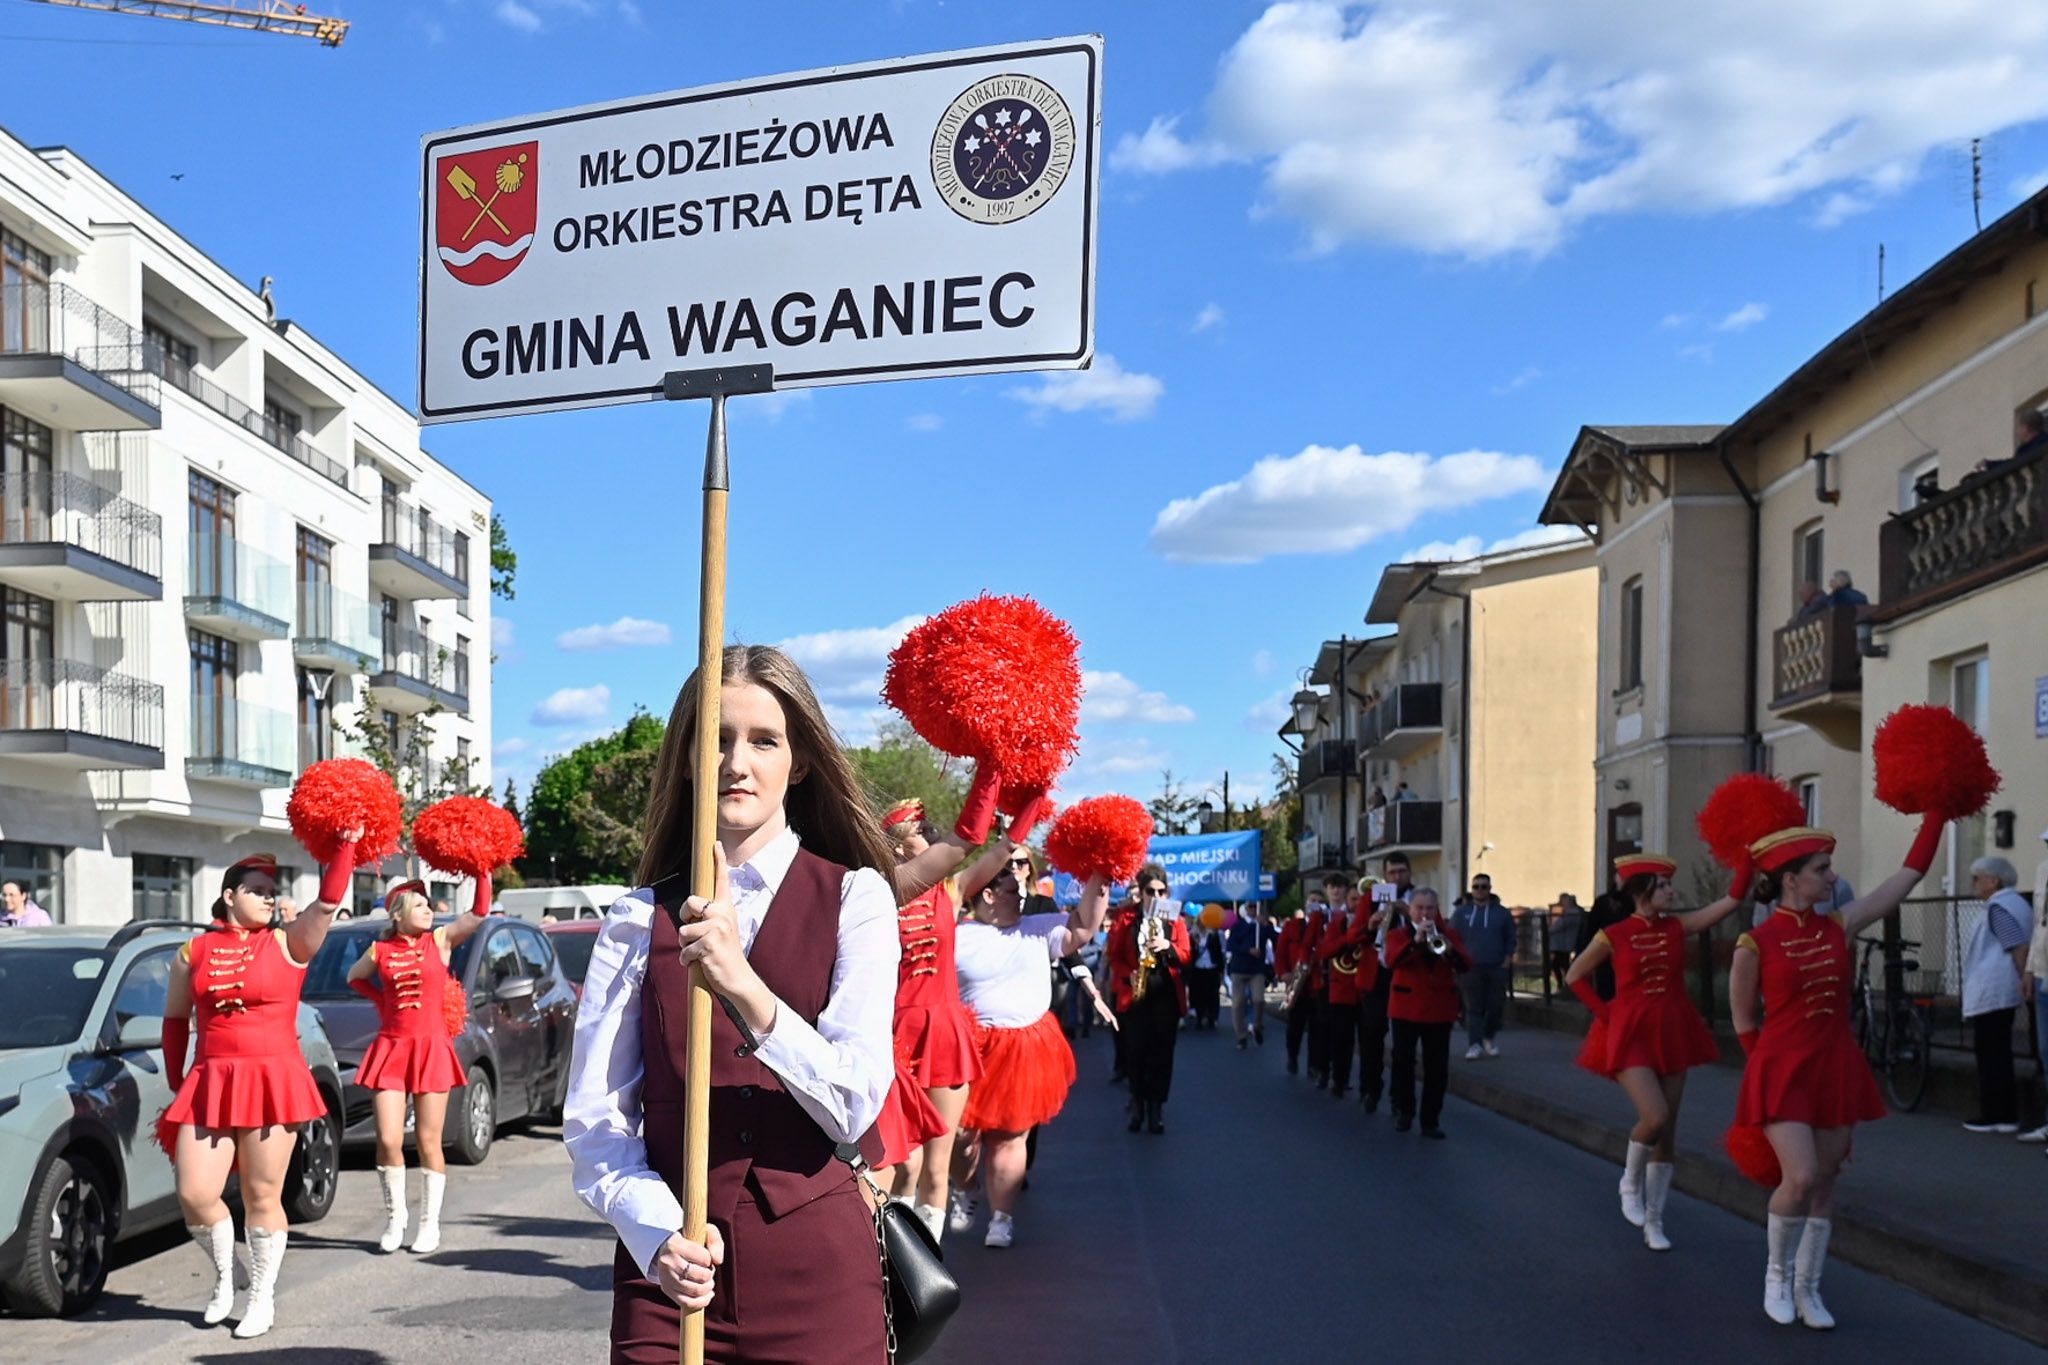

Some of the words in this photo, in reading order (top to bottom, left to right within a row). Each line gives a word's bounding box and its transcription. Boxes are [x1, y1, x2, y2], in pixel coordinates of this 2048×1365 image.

[580, 113, 894, 189] MŁODZIEŻOWA
[966, 80, 1034, 108] ORKIESTRA
[1043, 118, 1070, 191] WAGANIEC
[554, 190, 791, 252] ORKIESTRA
[805, 175, 921, 225] DĘTA
[986, 201, 1015, 217] 1997
[462, 311, 650, 379] GMINA
[667, 272, 1035, 356] WAGANIEC
[1167, 869, 1249, 885] CHOCINKU
[1181, 848, 1239, 864] MIEJSKI
